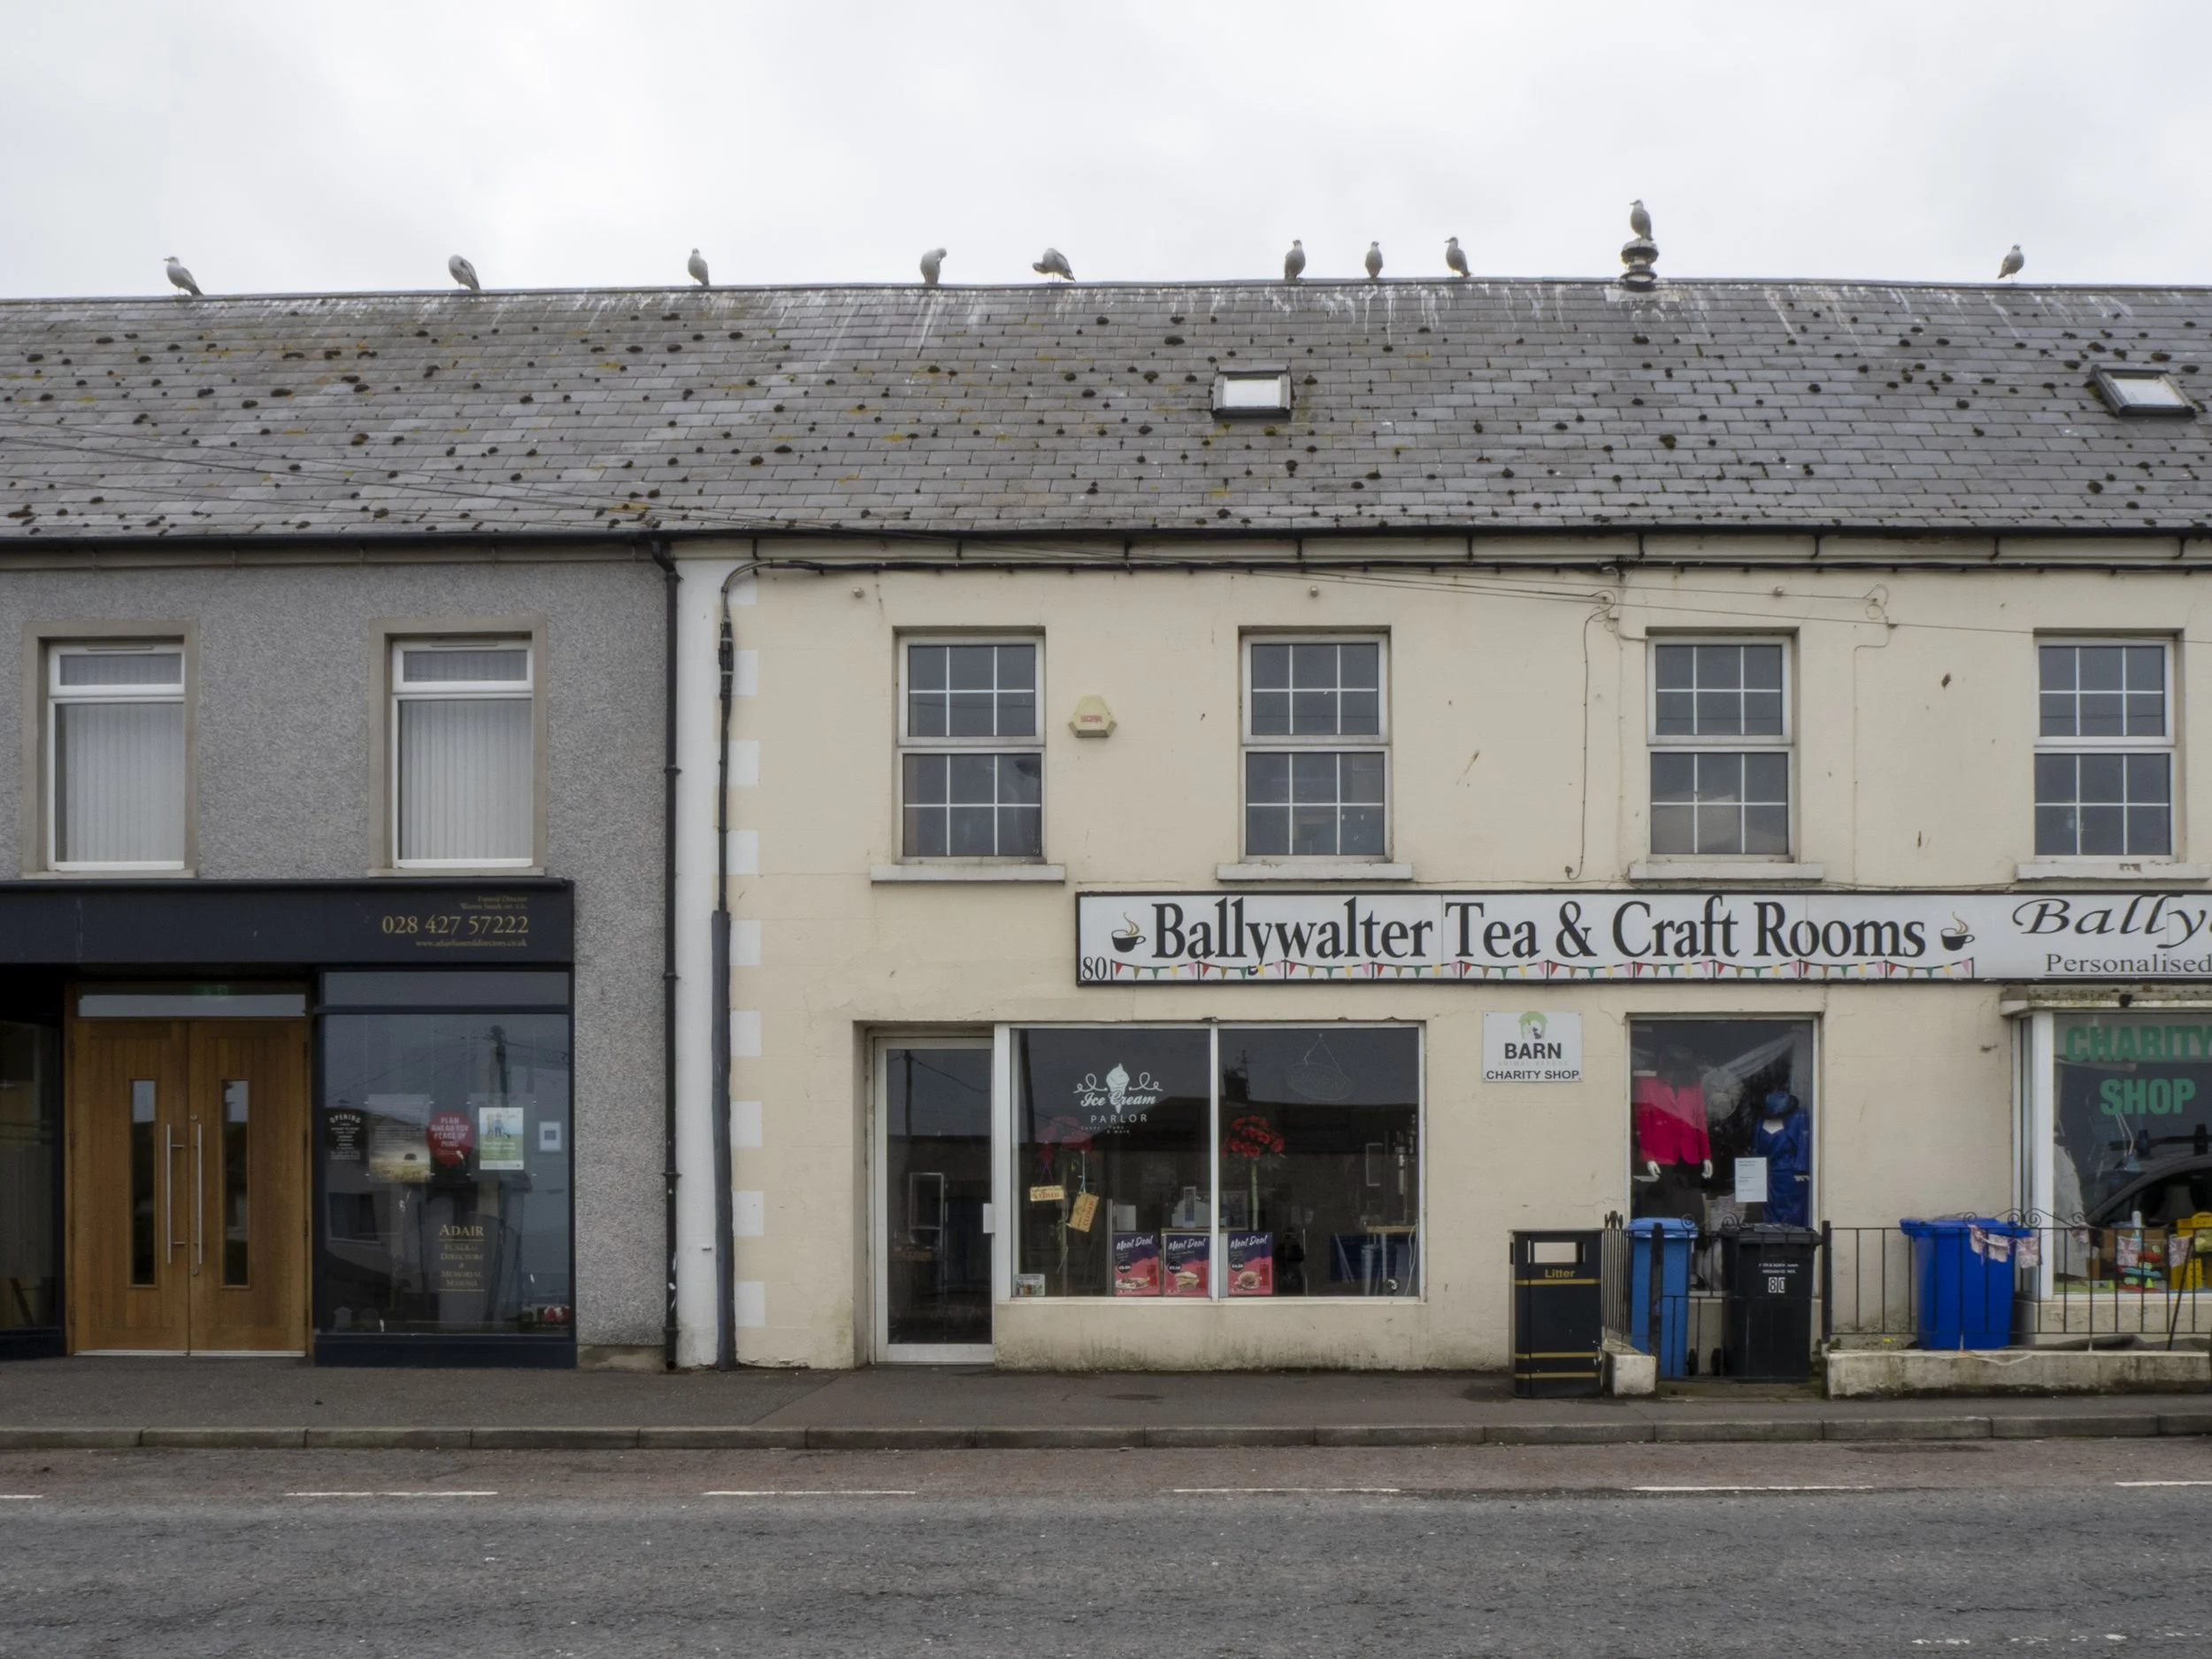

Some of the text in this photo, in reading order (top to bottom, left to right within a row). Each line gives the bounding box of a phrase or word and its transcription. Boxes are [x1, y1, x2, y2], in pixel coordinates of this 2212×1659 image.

[381, 914, 529, 935] 028 427 57222
[2012, 893, 2212, 949] Bally
[1151, 895, 1926, 976] Ballywalter Tea & Craft Rooms
[1081, 956, 1108, 981] 80
[2044, 953, 2212, 973] Personalised
[1504, 1042, 1563, 1060] BARN
[2065, 1025, 2212, 1062] CHARITY
[1486, 1070, 1580, 1080] CHARITY SHOP
[1079, 1089, 1156, 1107] Ice Cream
[2100, 1078, 2196, 1116] SHOP
[329, 1113, 361, 1124] OPENING
[1090, 1113, 1148, 1124] PARLOR
[439, 1224, 485, 1237] ADAIR
[1116, 1235, 1154, 1251] Meal Deal
[1168, 1238, 1207, 1252] Meal Deal
[1230, 1234, 1268, 1249] Meal Deal
[1545, 1268, 1575, 1279] Litter
